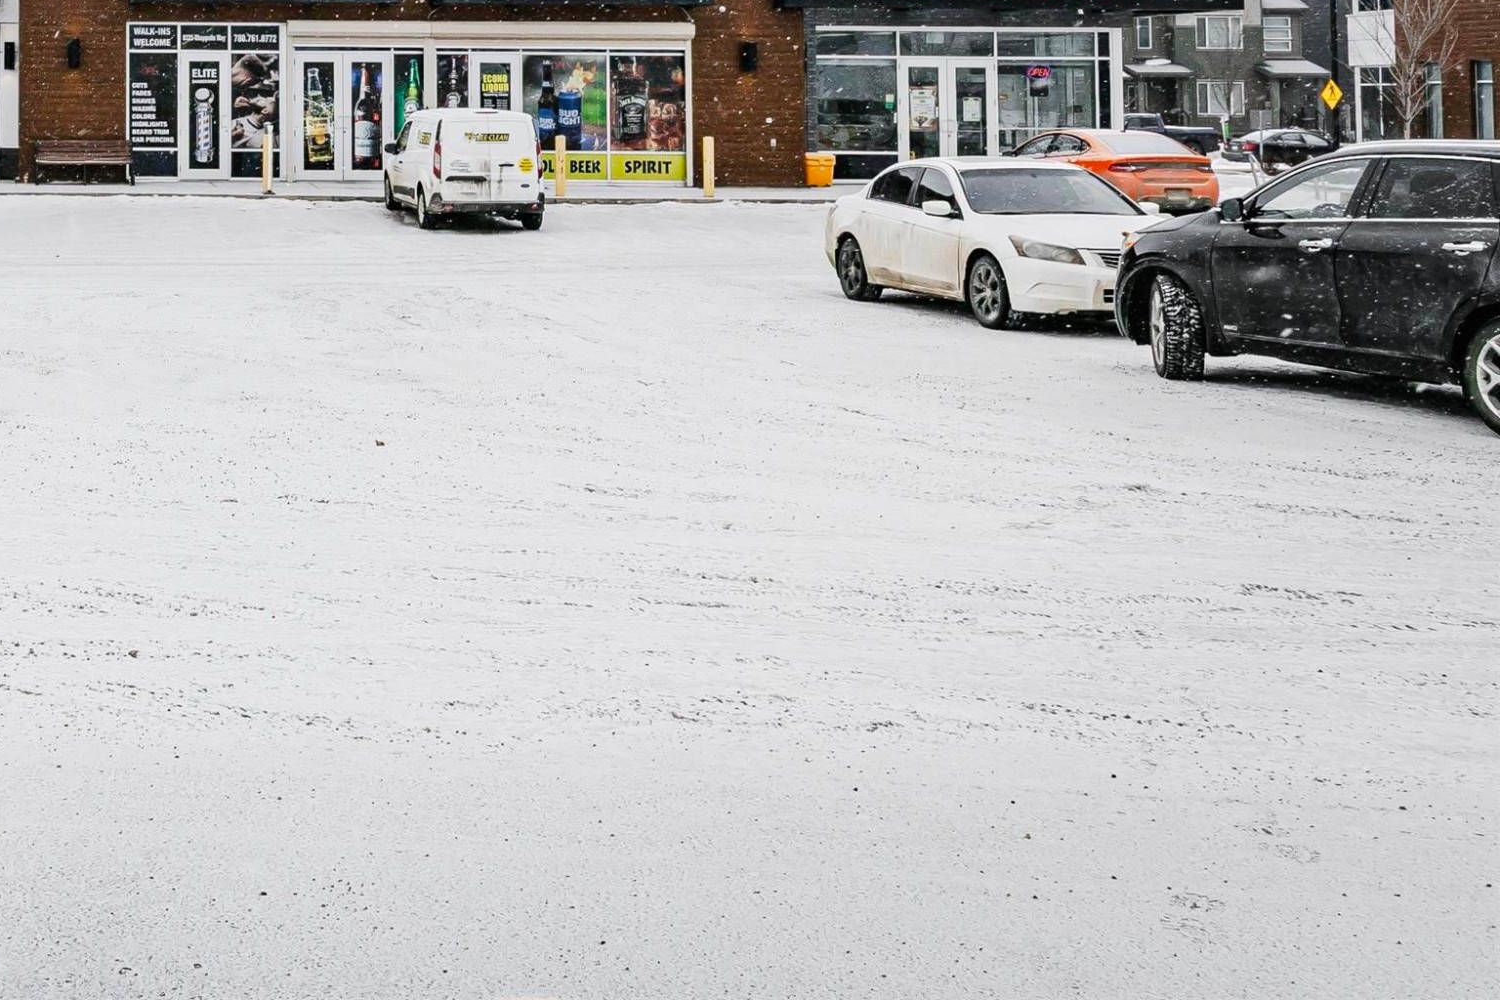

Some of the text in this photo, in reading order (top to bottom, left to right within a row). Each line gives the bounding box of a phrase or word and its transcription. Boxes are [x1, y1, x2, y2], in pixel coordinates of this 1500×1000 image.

[133, 27, 171, 36] WALK-INS
[133, 38, 171, 47] WELCOME
[191, 68, 218, 78] ELITE
[1030, 68, 1049, 77] OPEN
[558, 109, 579, 119] BUD
[570, 160, 601, 174] BEER
[624, 160, 672, 174] SPIRIT
